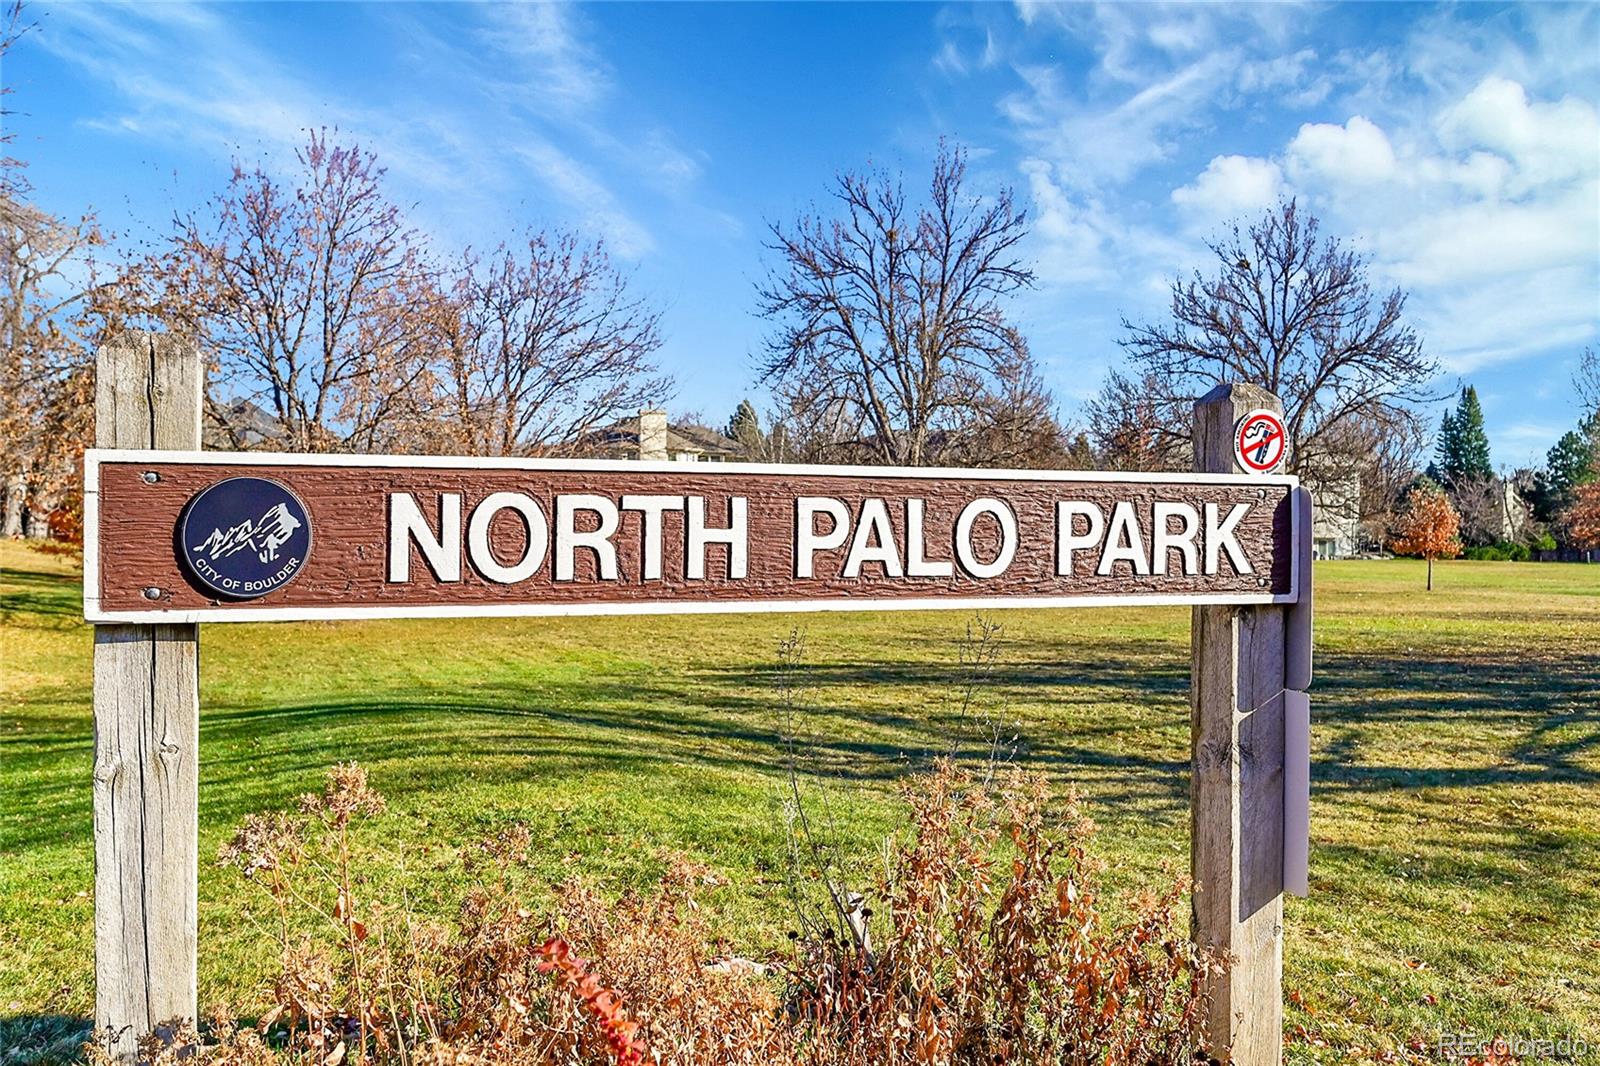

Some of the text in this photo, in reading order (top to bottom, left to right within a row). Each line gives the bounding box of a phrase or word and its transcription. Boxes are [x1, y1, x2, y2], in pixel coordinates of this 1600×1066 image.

[390, 491, 1254, 584] NORTH PALO PARK
[195, 557, 300, 591] CITY OF BOULDER
